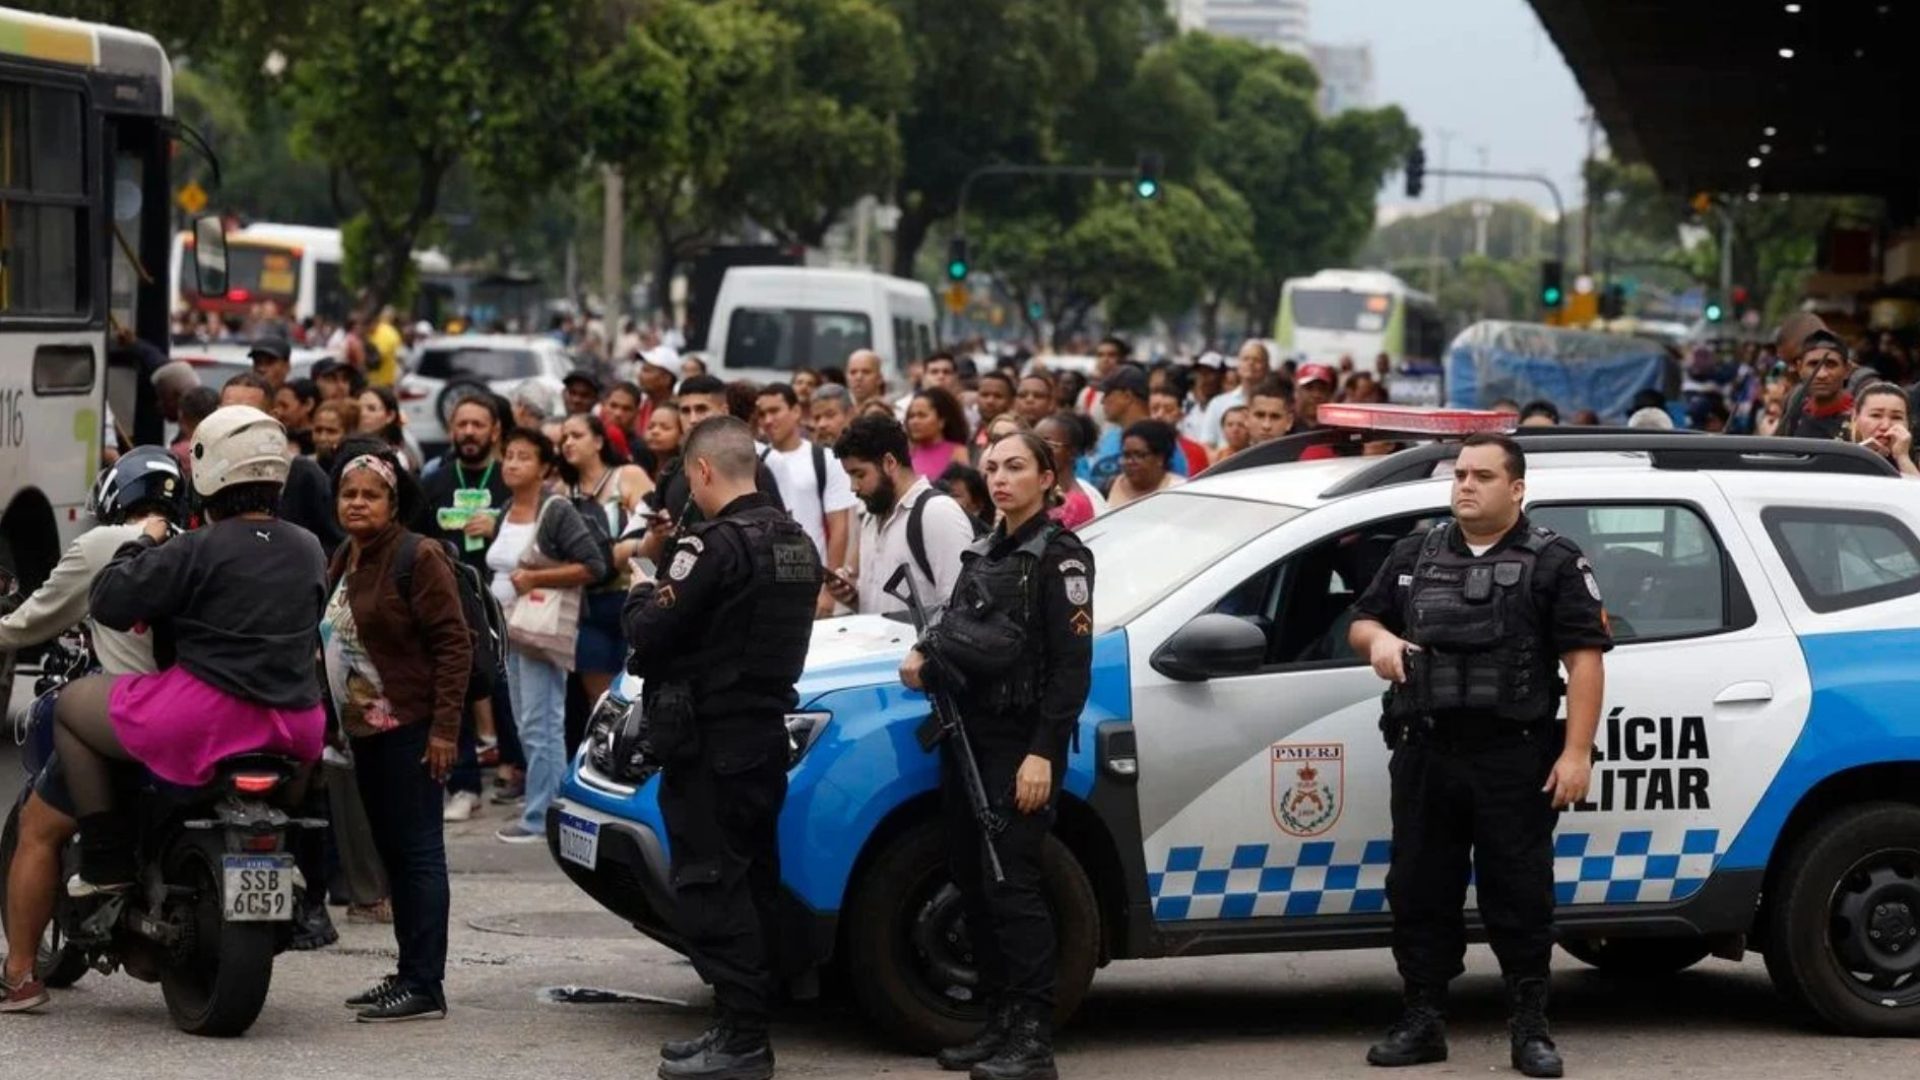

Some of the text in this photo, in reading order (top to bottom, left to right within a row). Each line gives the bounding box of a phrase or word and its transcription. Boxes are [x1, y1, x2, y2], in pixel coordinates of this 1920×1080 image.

[1591, 706, 1710, 761] ÍCIA
[1275, 747, 1339, 758] PMERJ
[1574, 767, 1710, 811] ITAR
[240, 869, 279, 891] SSB
[234, 892, 284, 914] 6C59
